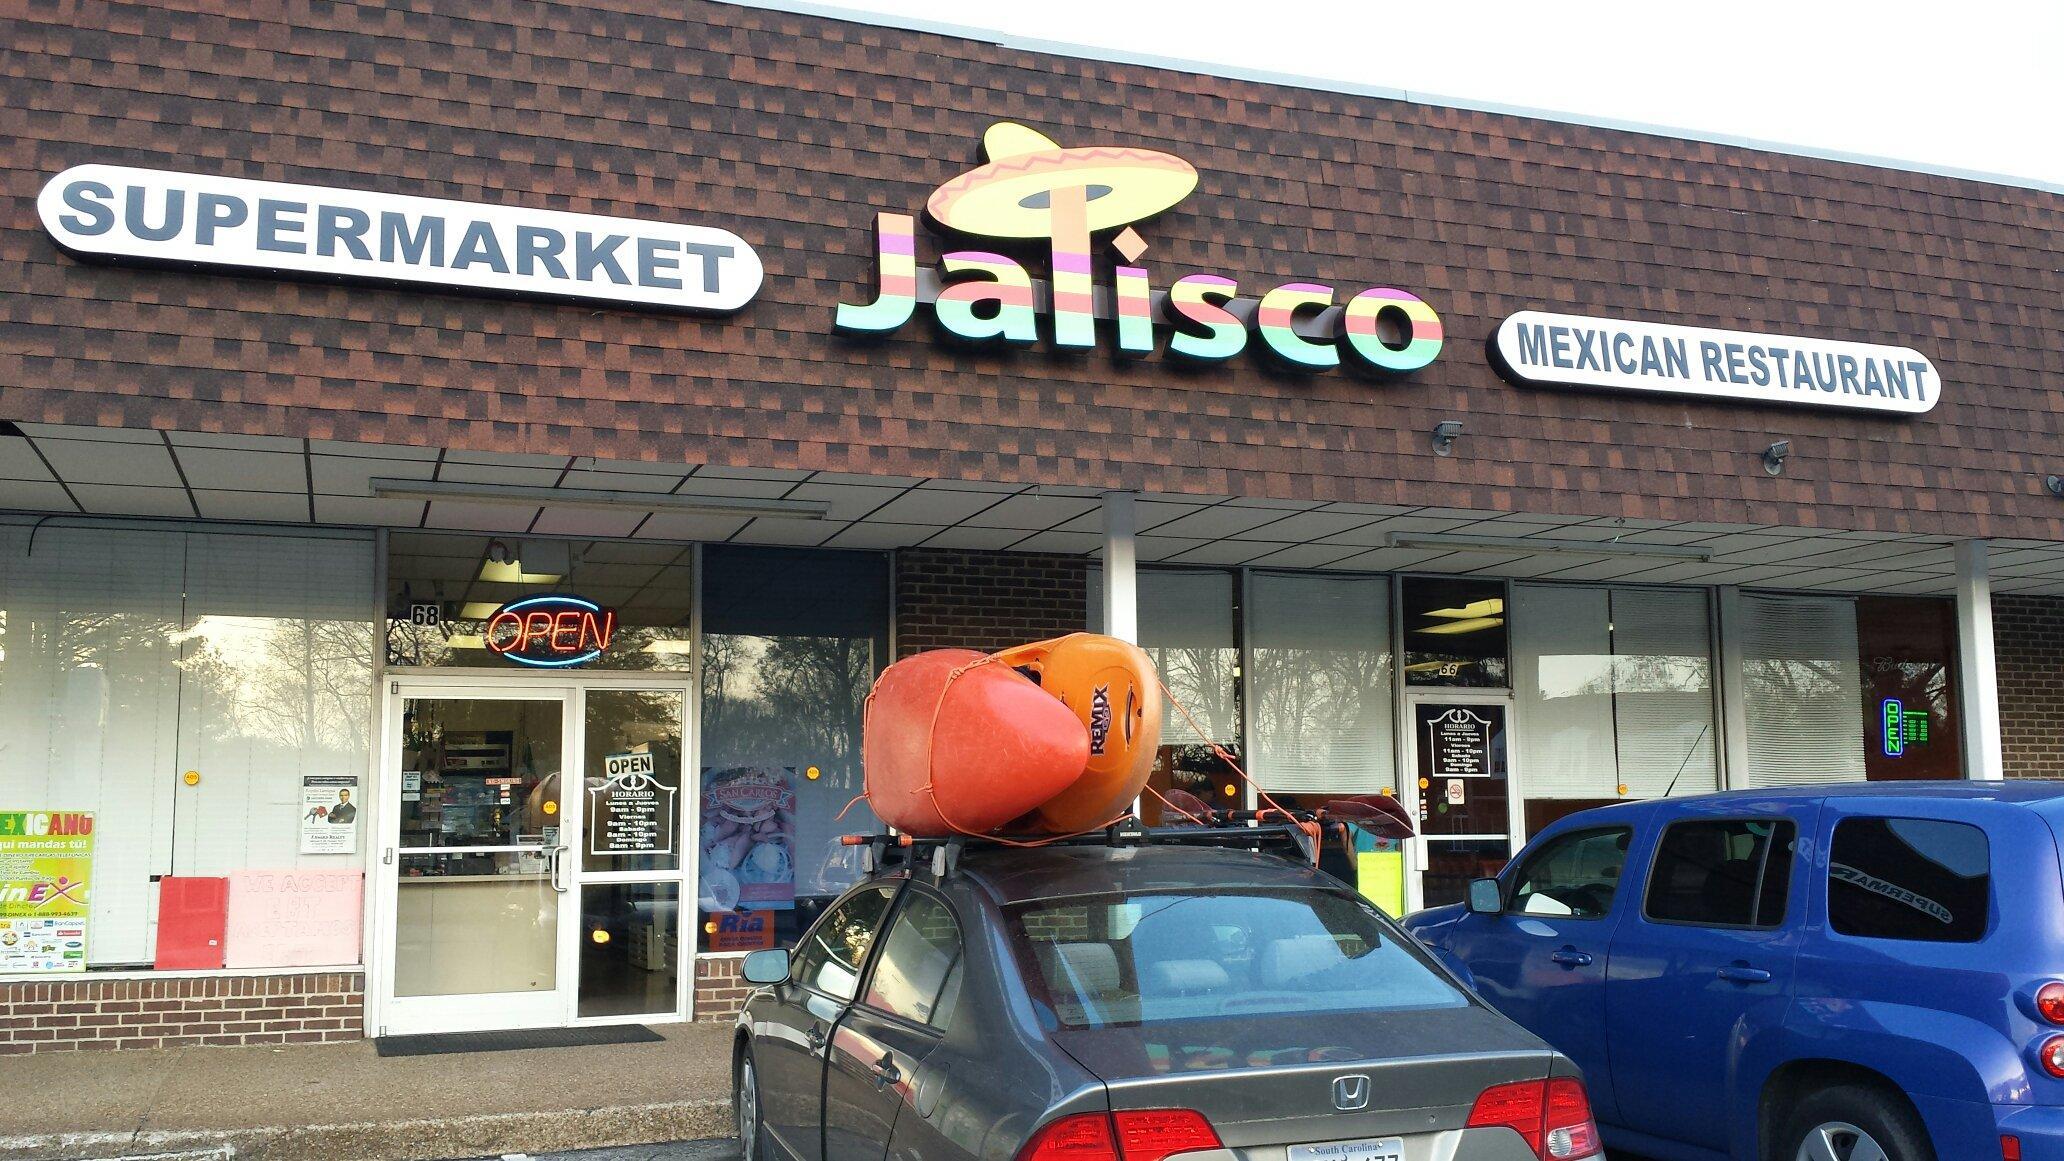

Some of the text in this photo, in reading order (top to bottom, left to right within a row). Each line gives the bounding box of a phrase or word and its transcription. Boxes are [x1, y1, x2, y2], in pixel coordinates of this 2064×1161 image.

[58, 180, 735, 293] SUPERMARKET
[836, 211, 1445, 372] Jalisco
[1517, 322, 1928, 402] MEXICAN RESTAURANT
[412, 605, 439, 626] 68
[488, 612, 612, 652] OPEN
[1441, 664, 1457, 675] 66
[1091, 684, 1108, 756] REMIX
[1887, 703, 1900, 753] OPEN
[609, 756, 651, 775] OPEN
[611, 790, 655, 798] HORARIO
[720, 786, 779, 799] SAN CARLOS
[633, 820, 658, 828] 10pm
[18, 840, 66, 849] mandas
[633, 831, 658, 839] 10pm
[719, 911, 765, 932] Ria
[1315, 1143, 1378, 1156] South Carolina
